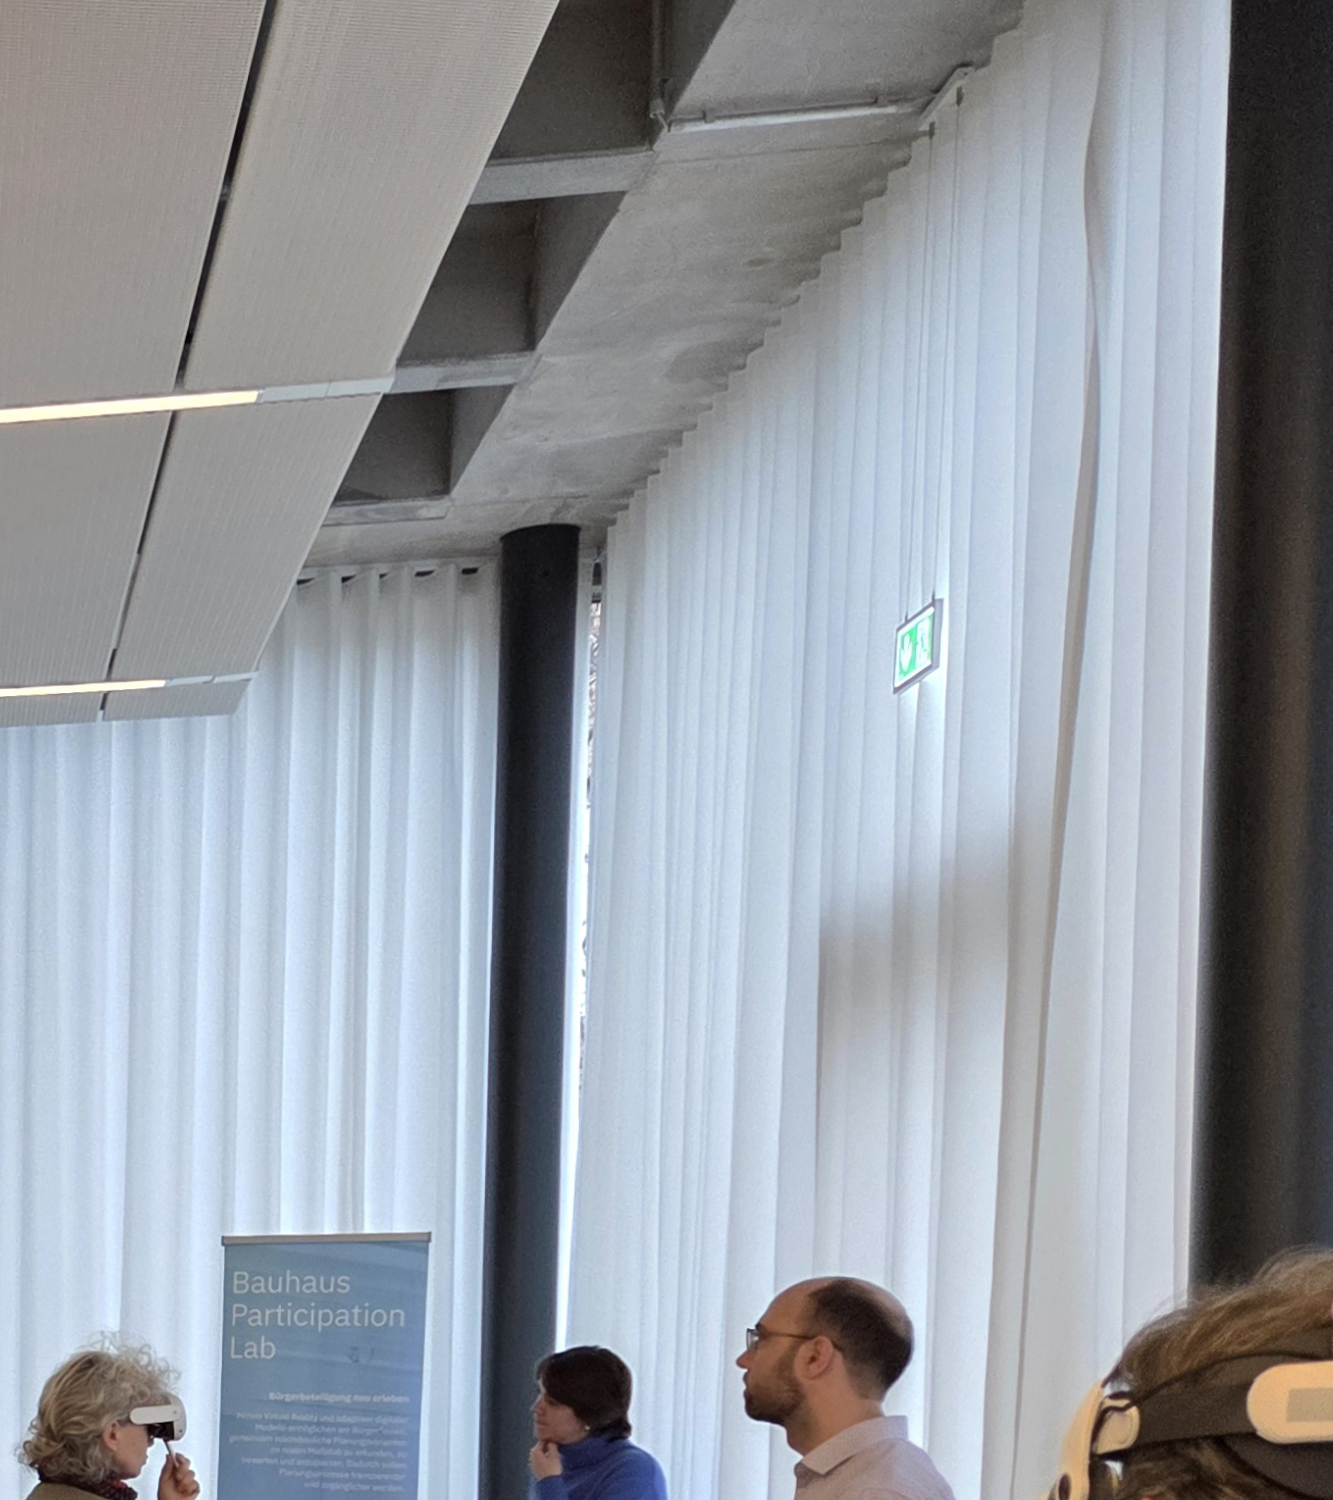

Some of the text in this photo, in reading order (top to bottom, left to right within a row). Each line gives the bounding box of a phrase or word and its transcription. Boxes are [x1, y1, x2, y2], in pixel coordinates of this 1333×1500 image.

[233, 1270, 351, 1294] Bauhaus
[232, 1302, 406, 1333] Participation
[230, 1335, 276, 1360] Lab
